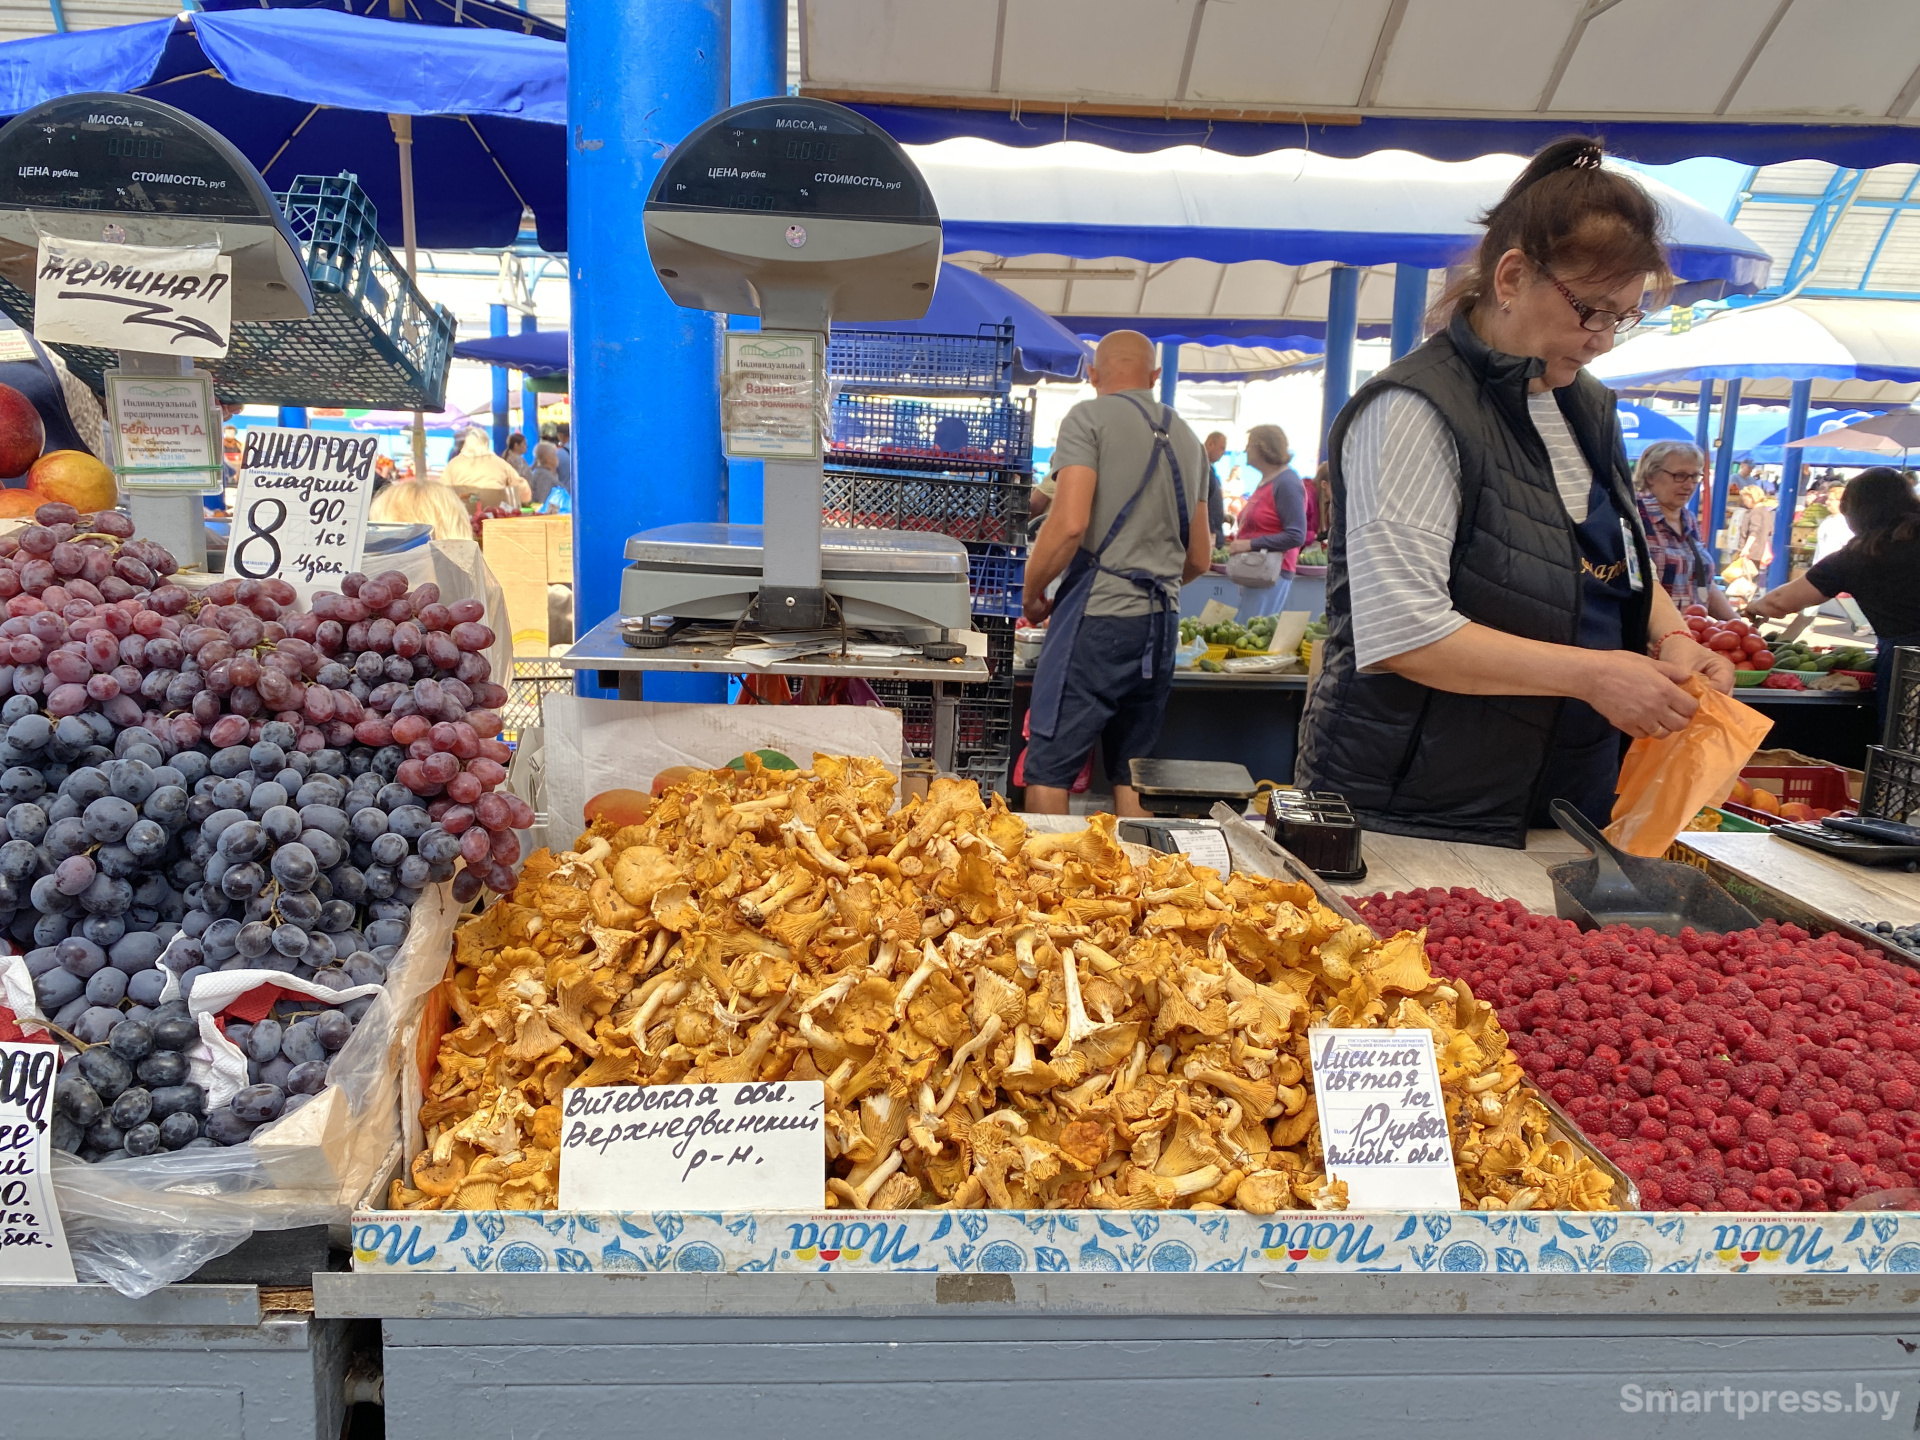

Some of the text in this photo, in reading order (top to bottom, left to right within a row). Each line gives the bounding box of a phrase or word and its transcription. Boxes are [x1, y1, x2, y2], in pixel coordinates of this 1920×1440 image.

[18, 166, 50, 178] ЦЕНА
[708, 167, 766, 179] ЦЕНА руб/кг
[209, 180, 226, 189] руб
[885, 181, 901, 190] руб
[737, 360, 805, 371] Индивидуальный
[123, 398, 197, 409] Индивидуальный
[124, 411, 198, 420] предприниматель
[121, 423, 179, 437] Белецкая
[254, 473, 359, 501] сладкий
[564, 1086, 718, 1117] Витебская
[563, 1099, 825, 1159] Верхнедвинский
